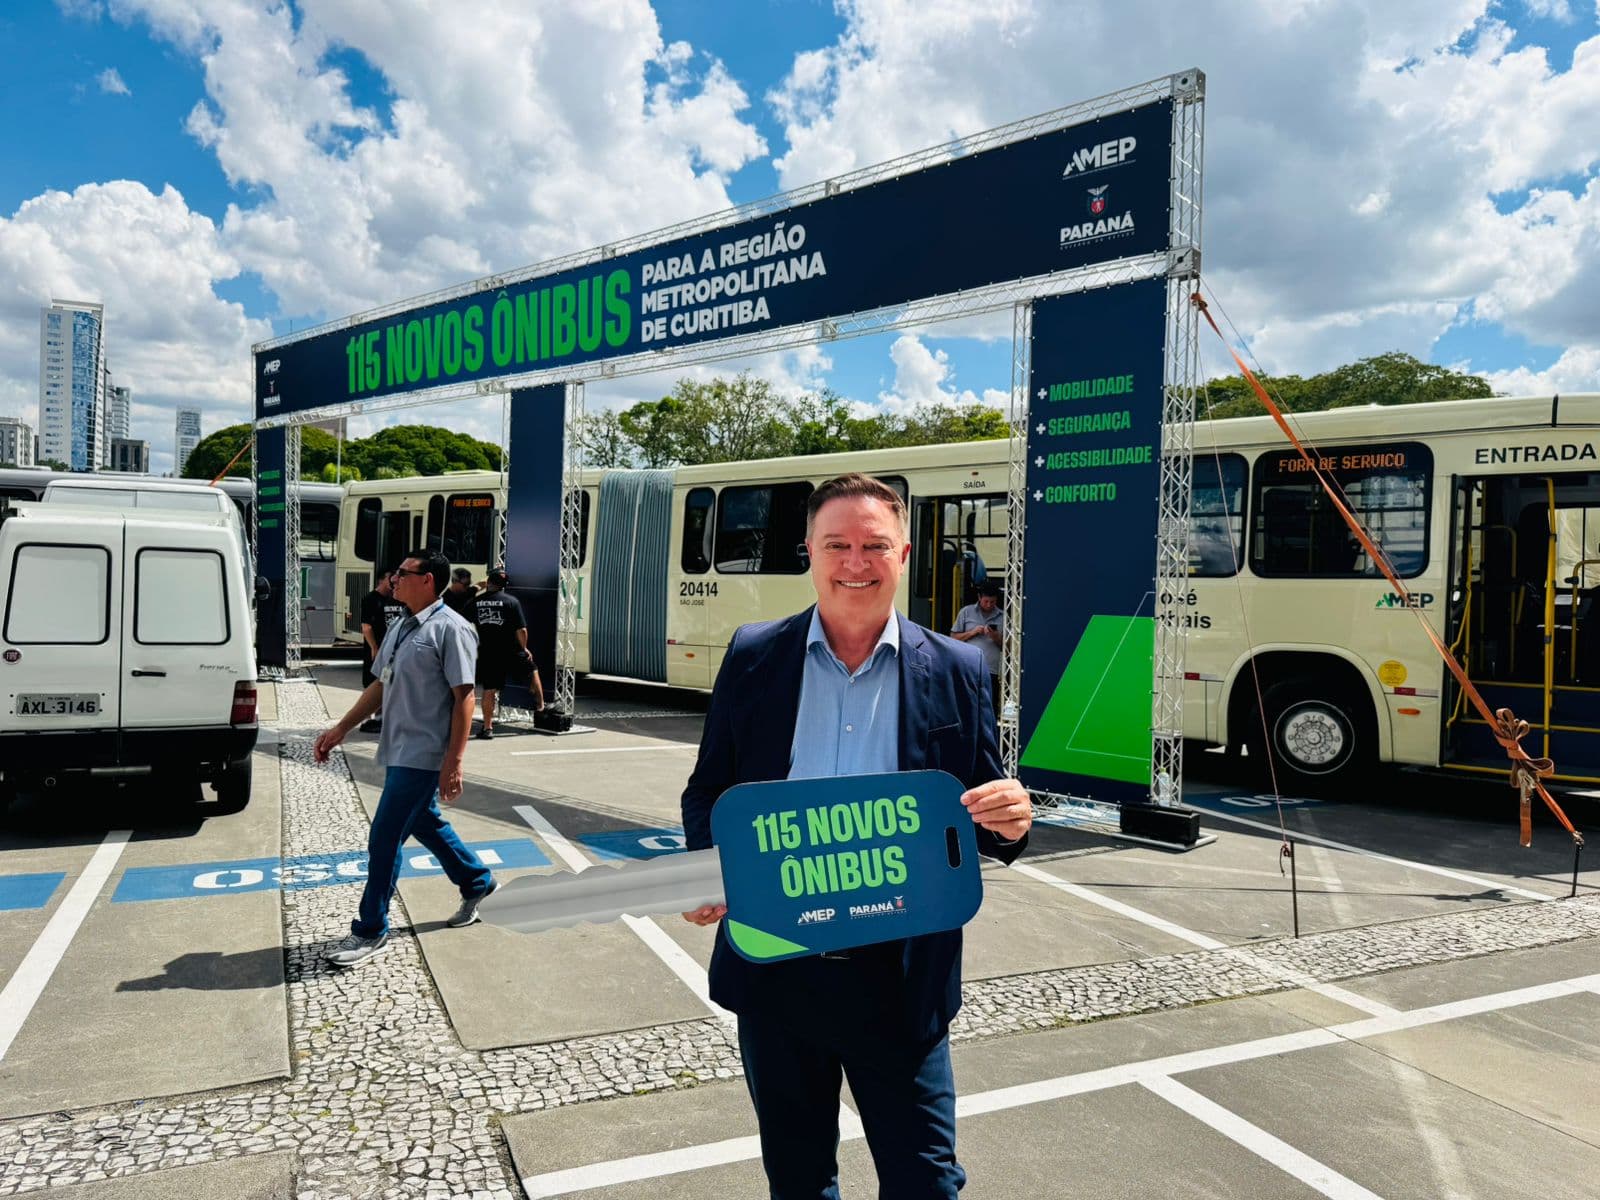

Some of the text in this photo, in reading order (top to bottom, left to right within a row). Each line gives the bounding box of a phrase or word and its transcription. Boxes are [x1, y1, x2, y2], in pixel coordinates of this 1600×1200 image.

[1063, 136, 1137, 176] AMEP
[1060, 210, 1135, 242] PARANÁ
[642, 221, 806, 286] PARA A REGIÃO
[641, 251, 827, 314] METROPOLITANA
[346, 269, 631, 393] 115 NOVOS ÔNIBUS
[641, 296, 771, 343] DE CURITIBA
[1049, 375, 1134, 402] MOBILIDADE
[1048, 411, 1131, 436] SEGURANÇA
[1046, 446, 1152, 470] ACESSIBILIDADE
[1279, 457, 1315, 473] FORA
[1475, 443, 1597, 464] ENTRADA
[1045, 483, 1116, 503] CONFORTO
[680, 581, 719, 597] 20414
[1375, 592, 1434, 608] AMEP
[752, 795, 921, 852] 115 NOVOS
[780, 845, 908, 898] ÔNIBUS
[798, 908, 836, 924] AMEP
[849, 900, 894, 915] PARANÁ
